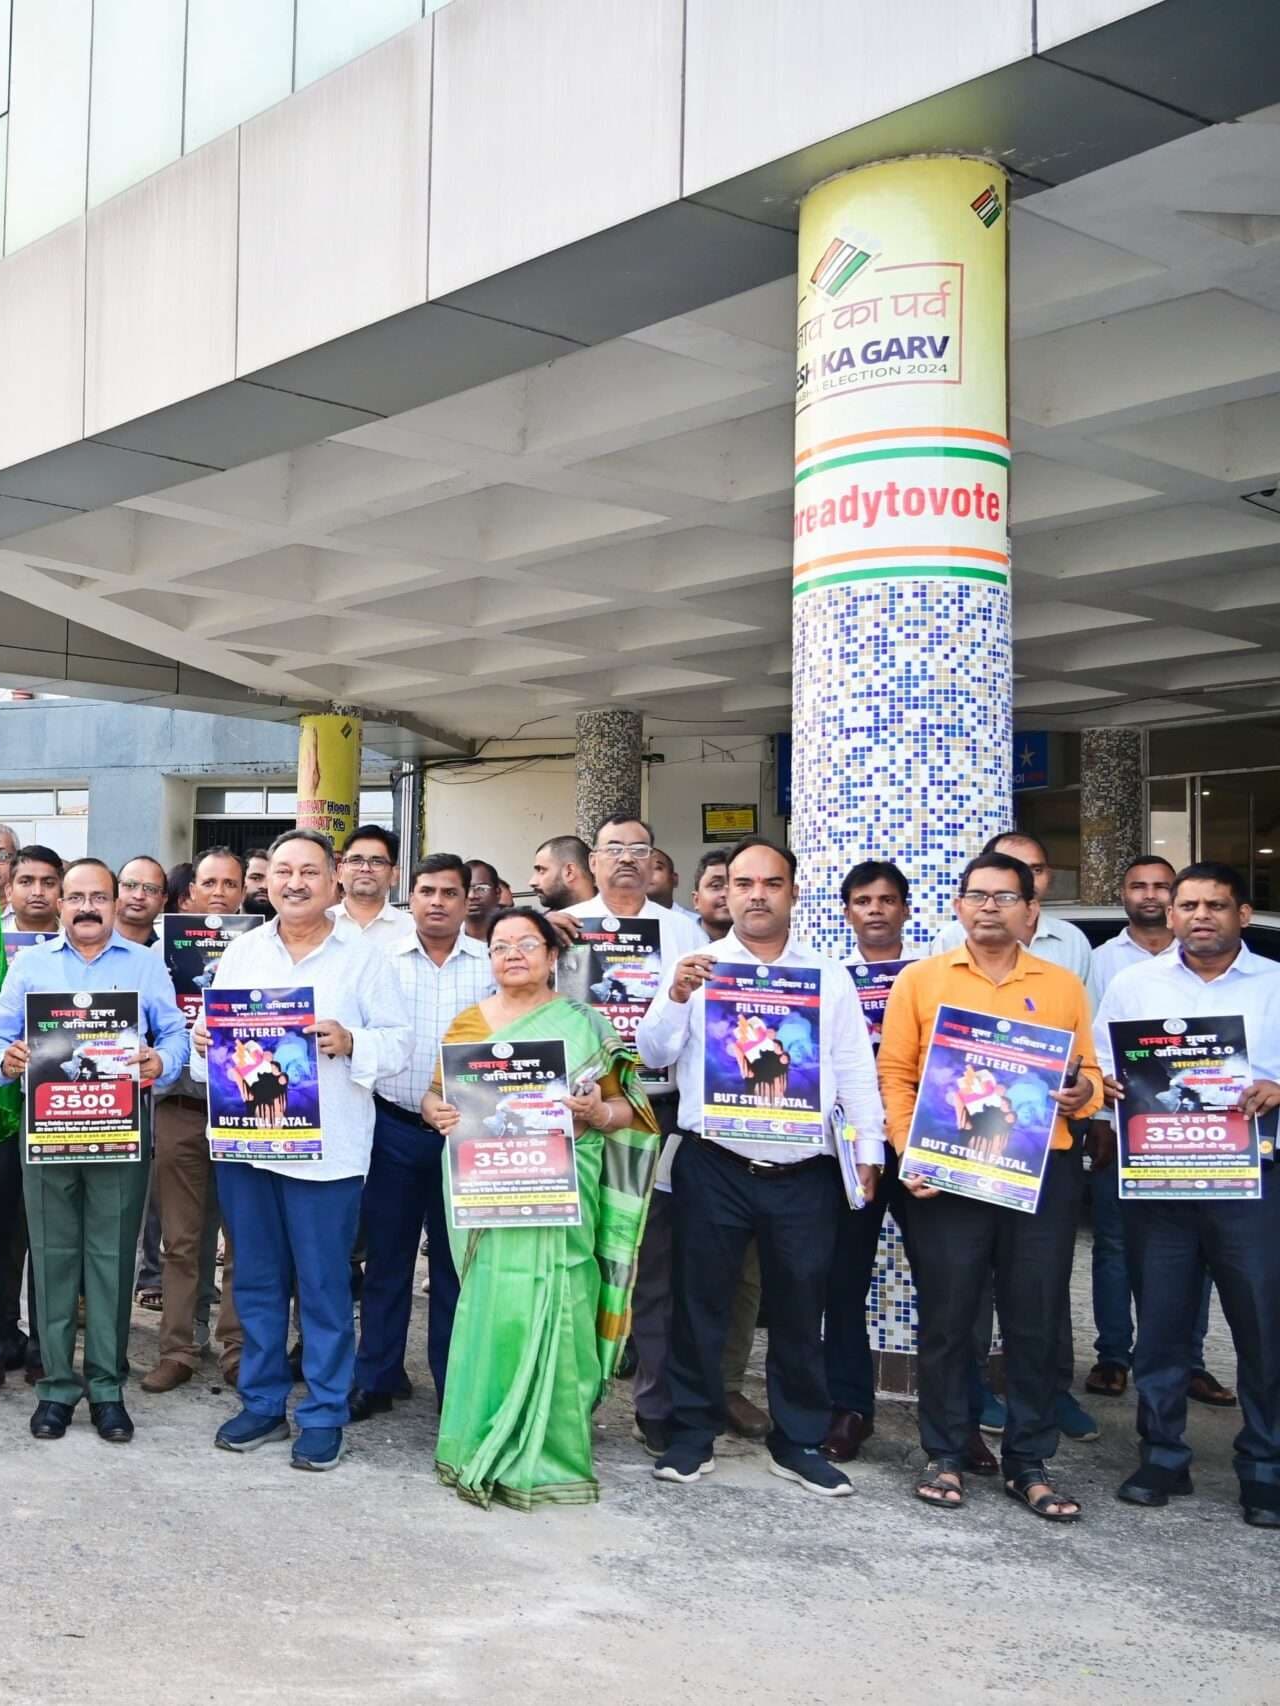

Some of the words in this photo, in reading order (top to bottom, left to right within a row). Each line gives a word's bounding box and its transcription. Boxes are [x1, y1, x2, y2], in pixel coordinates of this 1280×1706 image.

[832, 298, 882, 330] का
[890, 280, 952, 319] पर्व
[822, 347, 856, 376] KA
[861, 335, 950, 365] GARV
[823, 366, 901, 390] ELECTION
[907, 363, 948, 375] 2024
[637, 944, 653, 953] 3.0
[90, 1009, 116, 1020] मुक्त
[736, 1003, 790, 1015] FILTERED
[63, 1019, 107, 1029] अभियान
[111, 1021, 128, 1029] 3.0
[233, 1027, 286, 1038] FILTERED
[1186, 1034, 1218, 1044] मुक्त
[1154, 1046, 1208, 1056] अभियान
[1213, 1046, 1234, 1055] 3.0
[965, 1053, 1028, 1074] FILTERED
[536, 1070, 556, 1079] 3.0
[50, 1094, 116, 1108] 3500
[713, 1092, 738, 1103] BUT
[739, 1094, 772, 1106] STILL
[774, 1097, 814, 1109] FATAL.
[219, 1116, 240, 1127] BUT
[242, 1116, 272, 1128] STILL
[274, 1115, 312, 1127] FATAL.
[1146, 1127, 1226, 1141] 3500
[474, 1150, 547, 1167] 3500
[921, 1137, 949, 1152] BUT
[950, 1144, 986, 1162] STILL
[988, 1152, 1033, 1173] FATAL.
